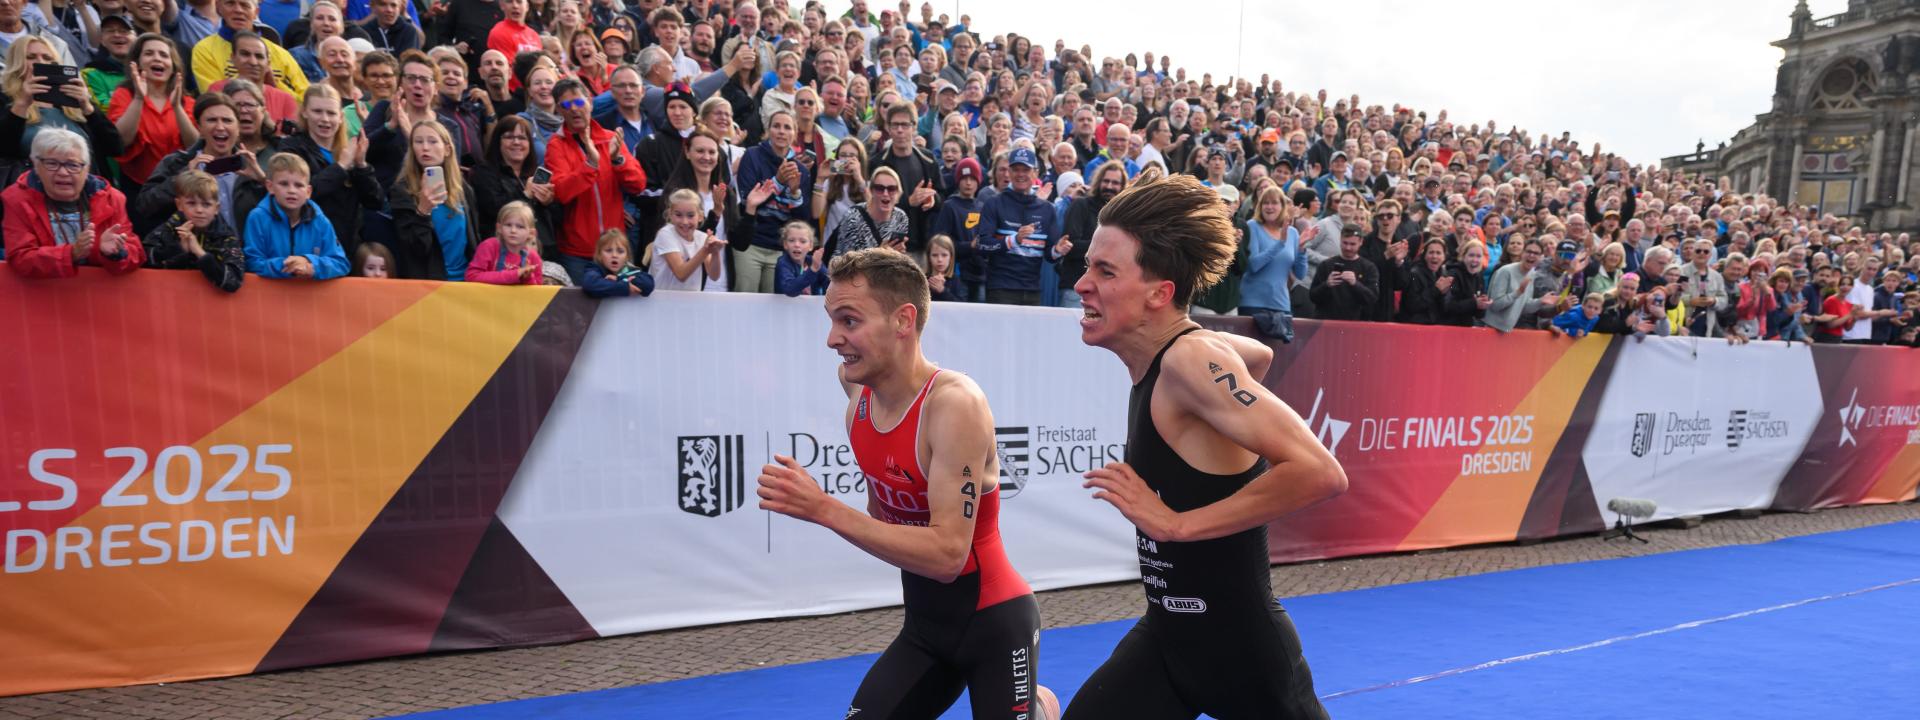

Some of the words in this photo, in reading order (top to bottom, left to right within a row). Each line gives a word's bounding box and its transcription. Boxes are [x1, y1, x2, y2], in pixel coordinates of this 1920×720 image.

[1214, 372, 1258, 407] 70
[1037, 425, 1097, 442] Freistaat
[1359, 417, 1399, 451] DIE
[1402, 415, 1484, 449] FINALS
[1485, 415, 1535, 446] 2025
[1746, 420, 1789, 439] SACHSEN
[101, 444, 293, 508] 2025
[1036, 443, 1127, 476] SACHS
[1461, 451, 1532, 476] DRESDEN
[961, 481, 977, 519] 40
[4, 515, 296, 574] DRESDEN
[1143, 574, 1168, 589] sailfish
[1167, 600, 1201, 610] ABUS
